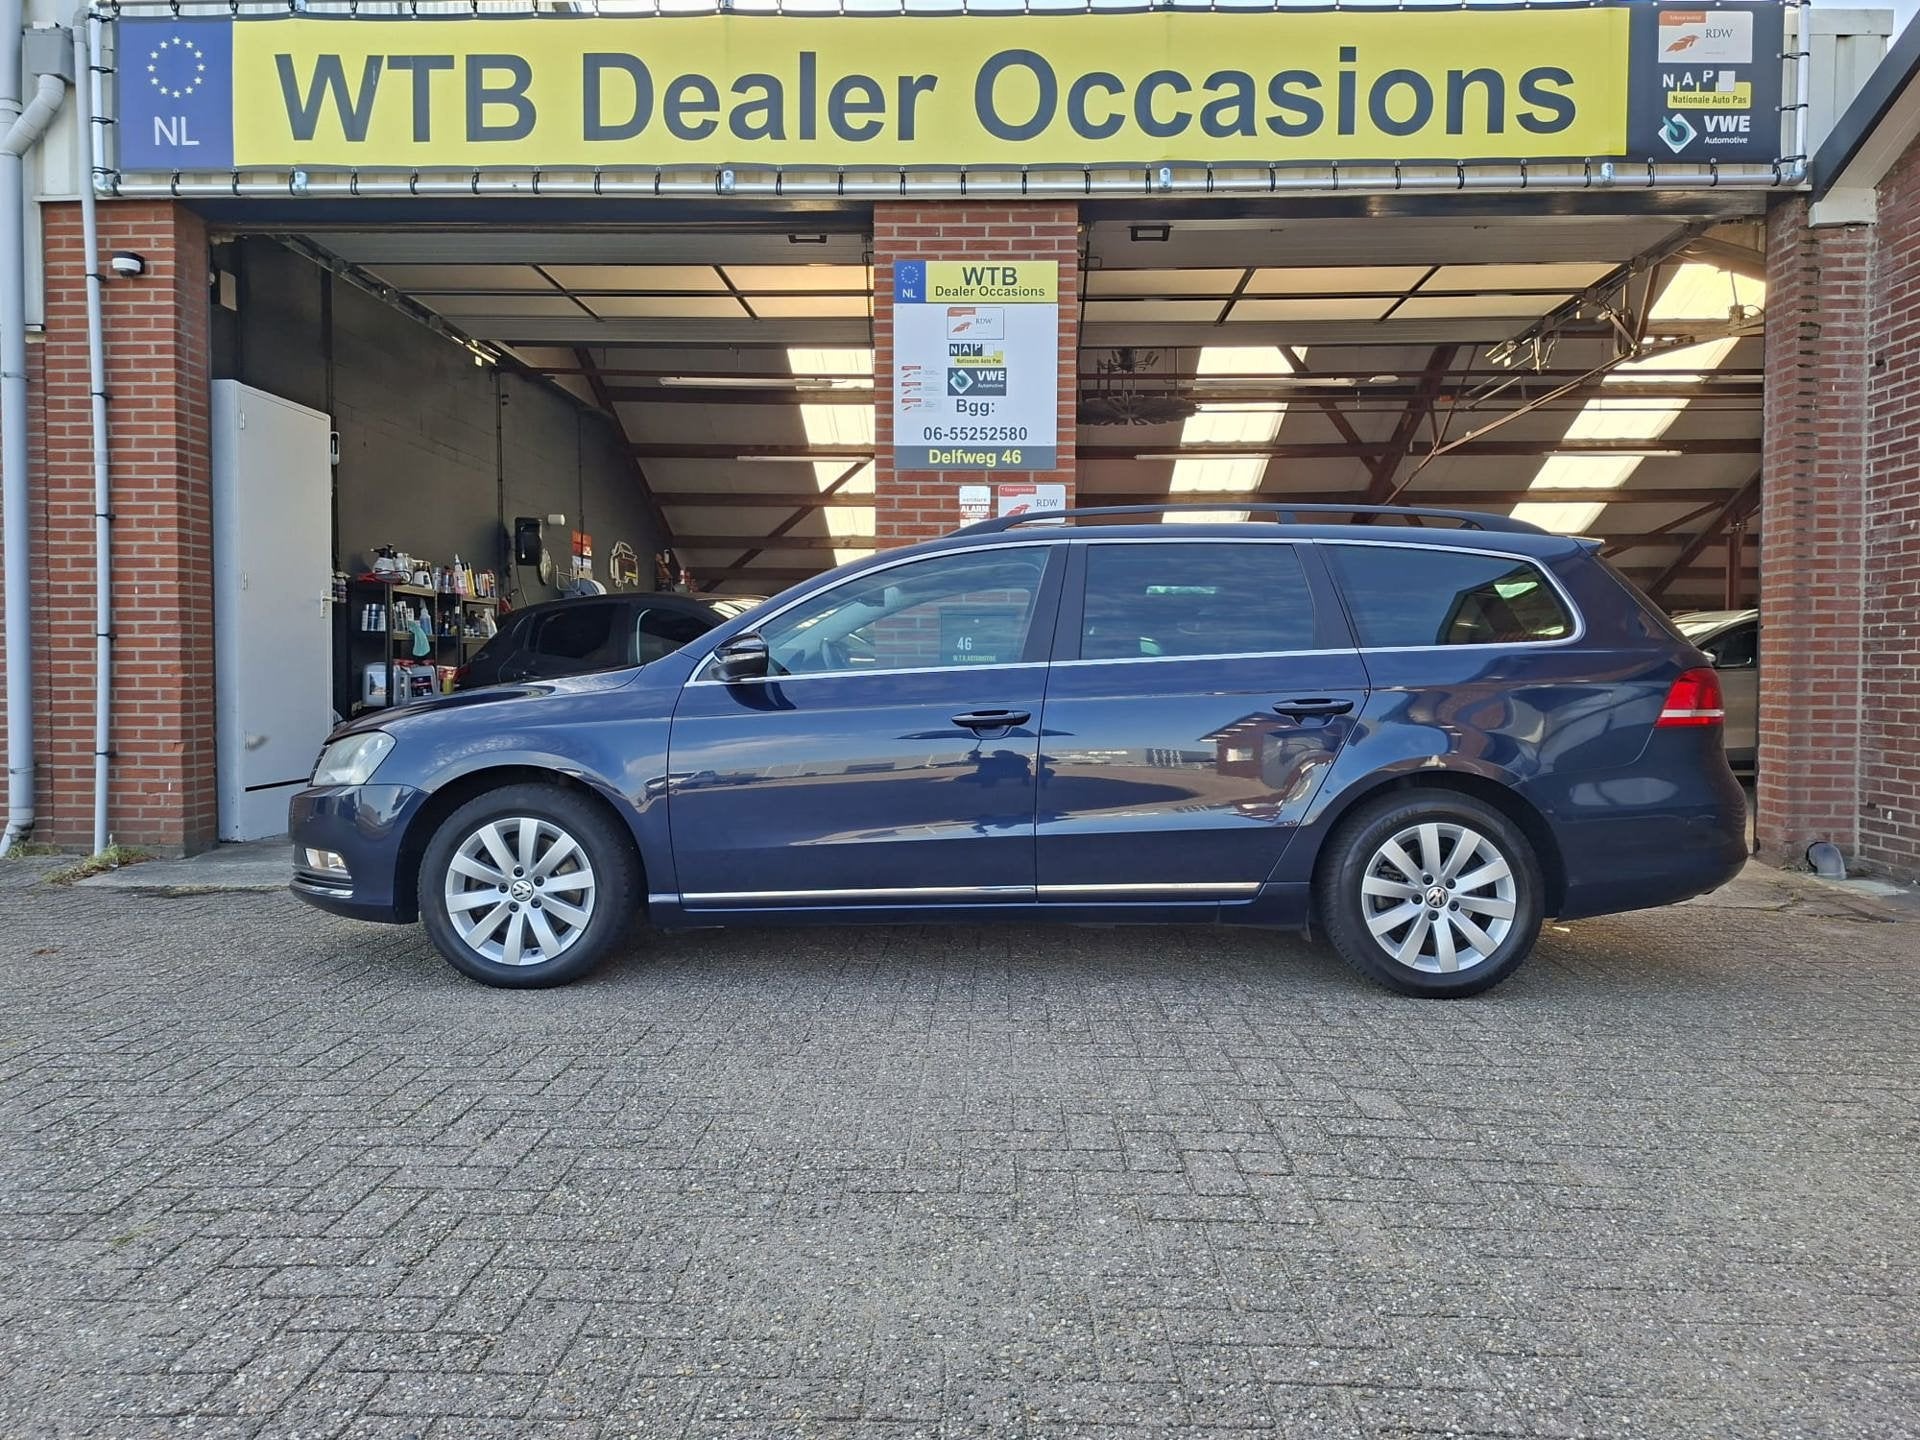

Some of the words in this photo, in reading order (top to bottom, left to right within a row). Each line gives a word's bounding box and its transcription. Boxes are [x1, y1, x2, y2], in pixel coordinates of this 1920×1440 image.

[1705, 28, 1733, 39] RDW
[274, 53, 537, 143] WTB
[582, 51, 939, 141] Dealer
[974, 46, 1577, 141] Occasions
[1672, 94, 1710, 104] Nationale
[1712, 94, 1730, 104] Auto
[1732, 94, 1747, 104] Pas
[1703, 115, 1751, 132] VWE
[153, 116, 200, 146] NL
[1704, 136, 1748, 144] Automotive
[962, 266, 1018, 286] WTB
[902, 288, 917, 299] NL
[935, 285, 976, 297] Dealer
[979, 285, 1045, 297] Occasions
[976, 370, 1005, 381] VWE
[956, 398, 995, 416] Bgg:
[923, 426, 1028, 441] 06-55252580
[928, 449, 997, 467] Delfweg
[1001, 449, 1022, 464] 46
[961, 505, 989, 513] ALARM
[1036, 498, 1058, 507] RDW
[957, 636, 972, 651] 46
